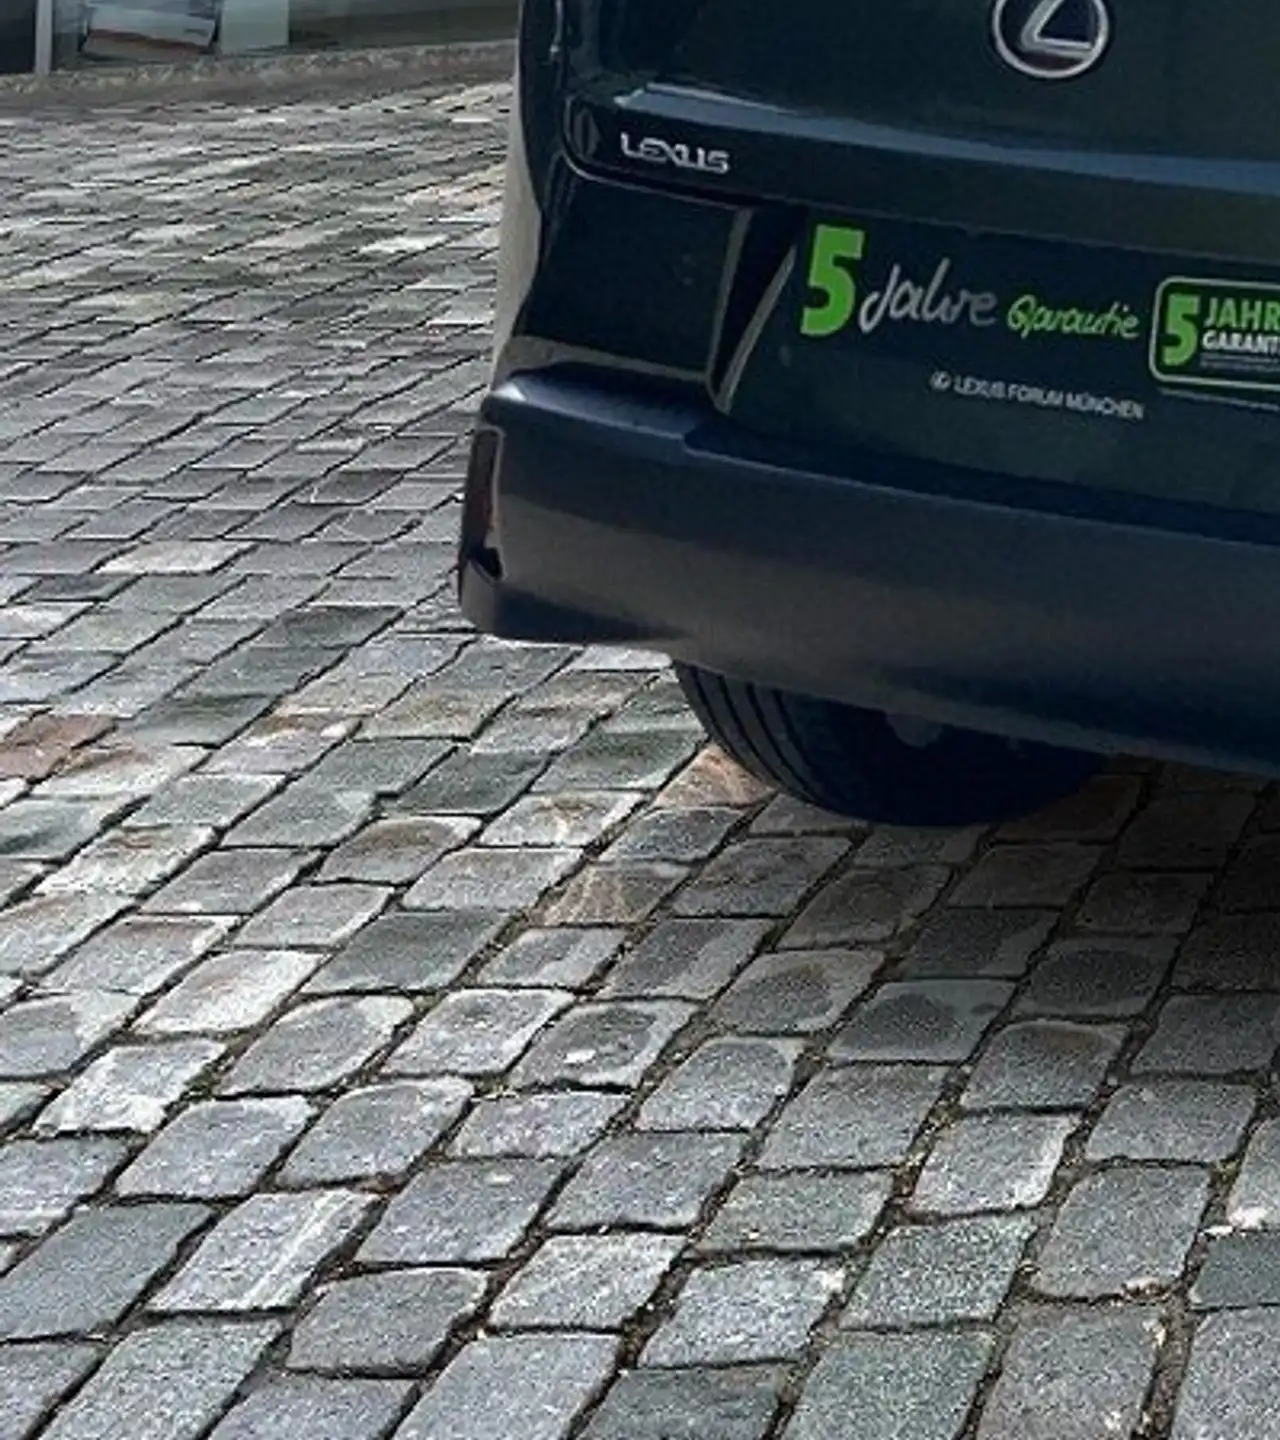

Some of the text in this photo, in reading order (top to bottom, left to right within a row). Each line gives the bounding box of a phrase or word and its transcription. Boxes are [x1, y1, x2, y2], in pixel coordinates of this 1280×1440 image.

[620, 131, 731, 175] LEXUS
[800, 224, 865, 337] 5
[858, 257, 998, 334] Jahre
[1163, 293, 1200, 367] 5
[953, 374, 1006, 399] LEXUS
[1007, 382, 1064, 406] FORUM
